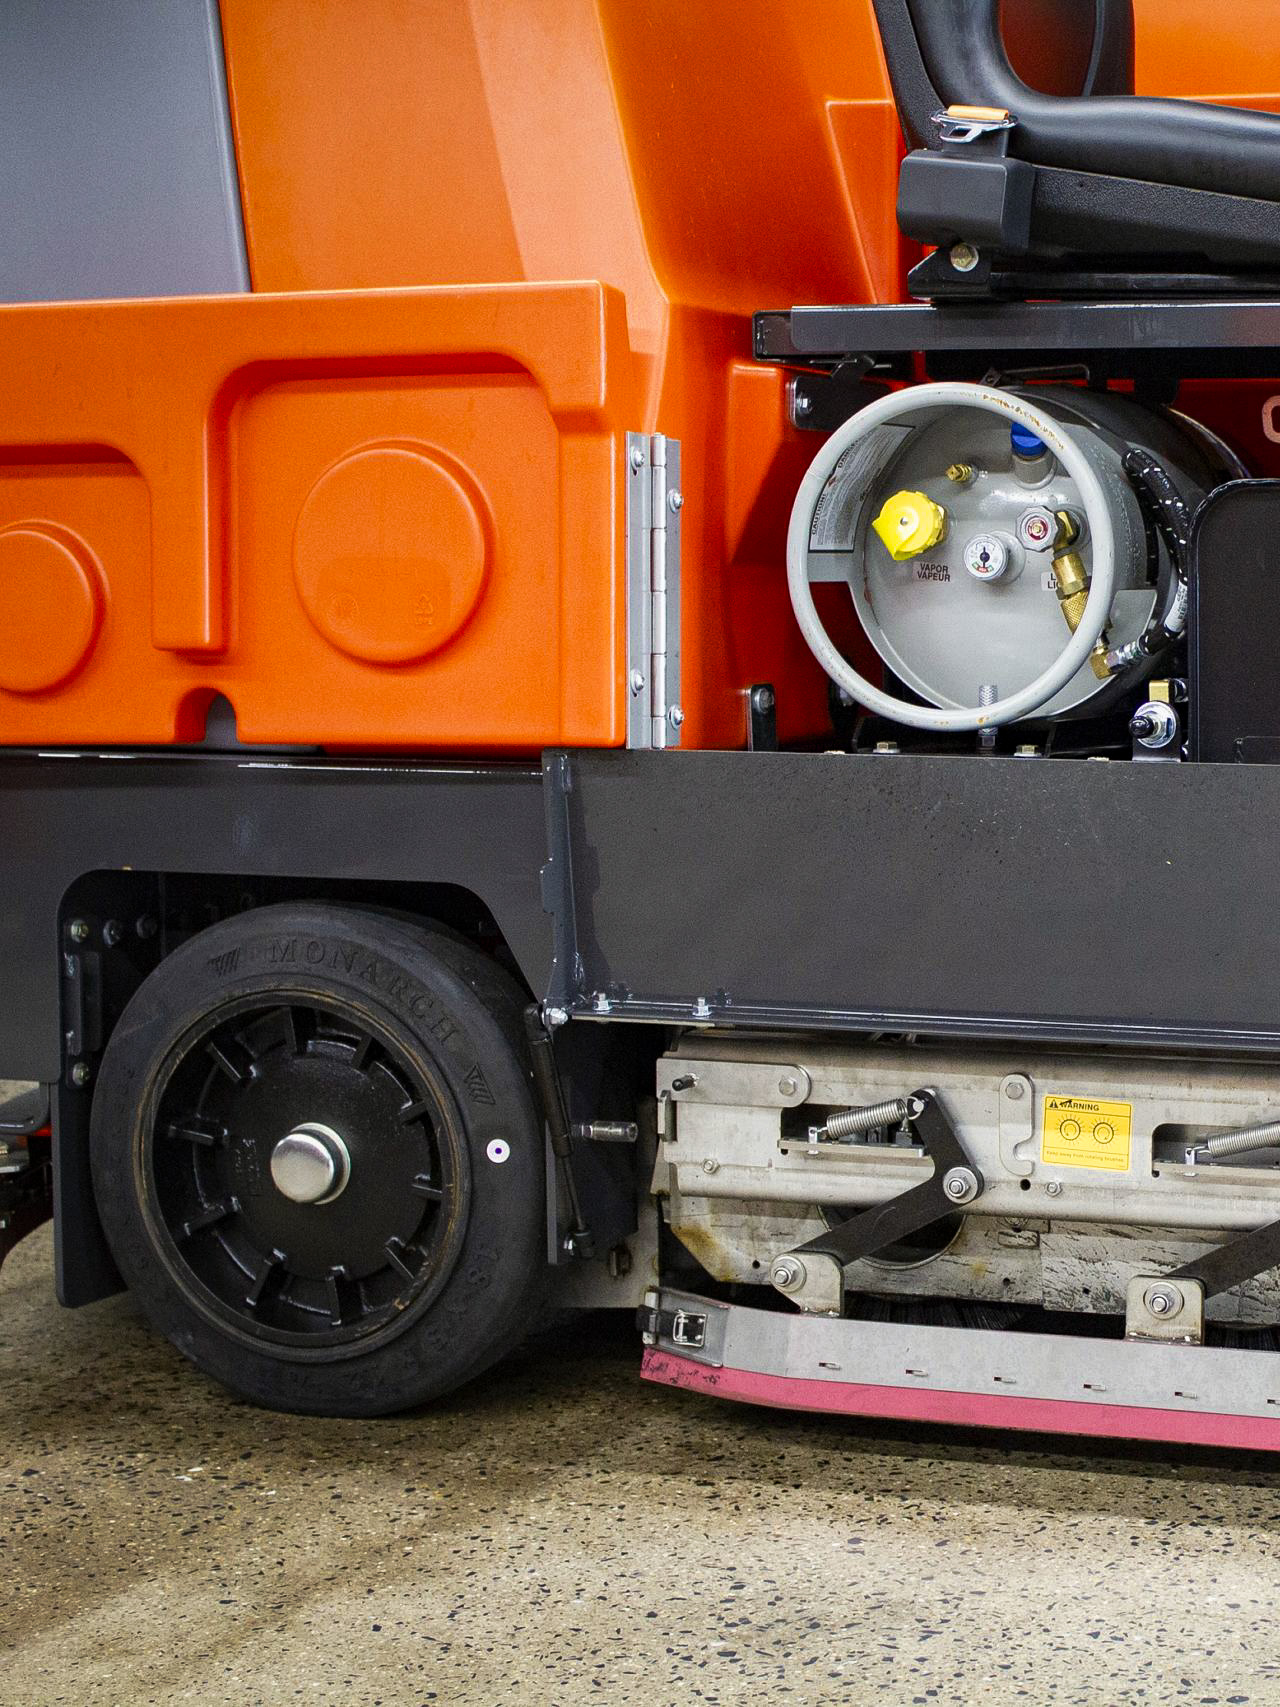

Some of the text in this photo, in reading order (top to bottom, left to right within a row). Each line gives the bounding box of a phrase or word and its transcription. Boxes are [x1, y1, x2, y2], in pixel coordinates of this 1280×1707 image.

[919, 563, 949, 574] VAPOR
[917, 571, 951, 582] VAPEUR
[270, 937, 461, 1045] MONARCH
[1060, 1101, 1099, 1112] WARNING
